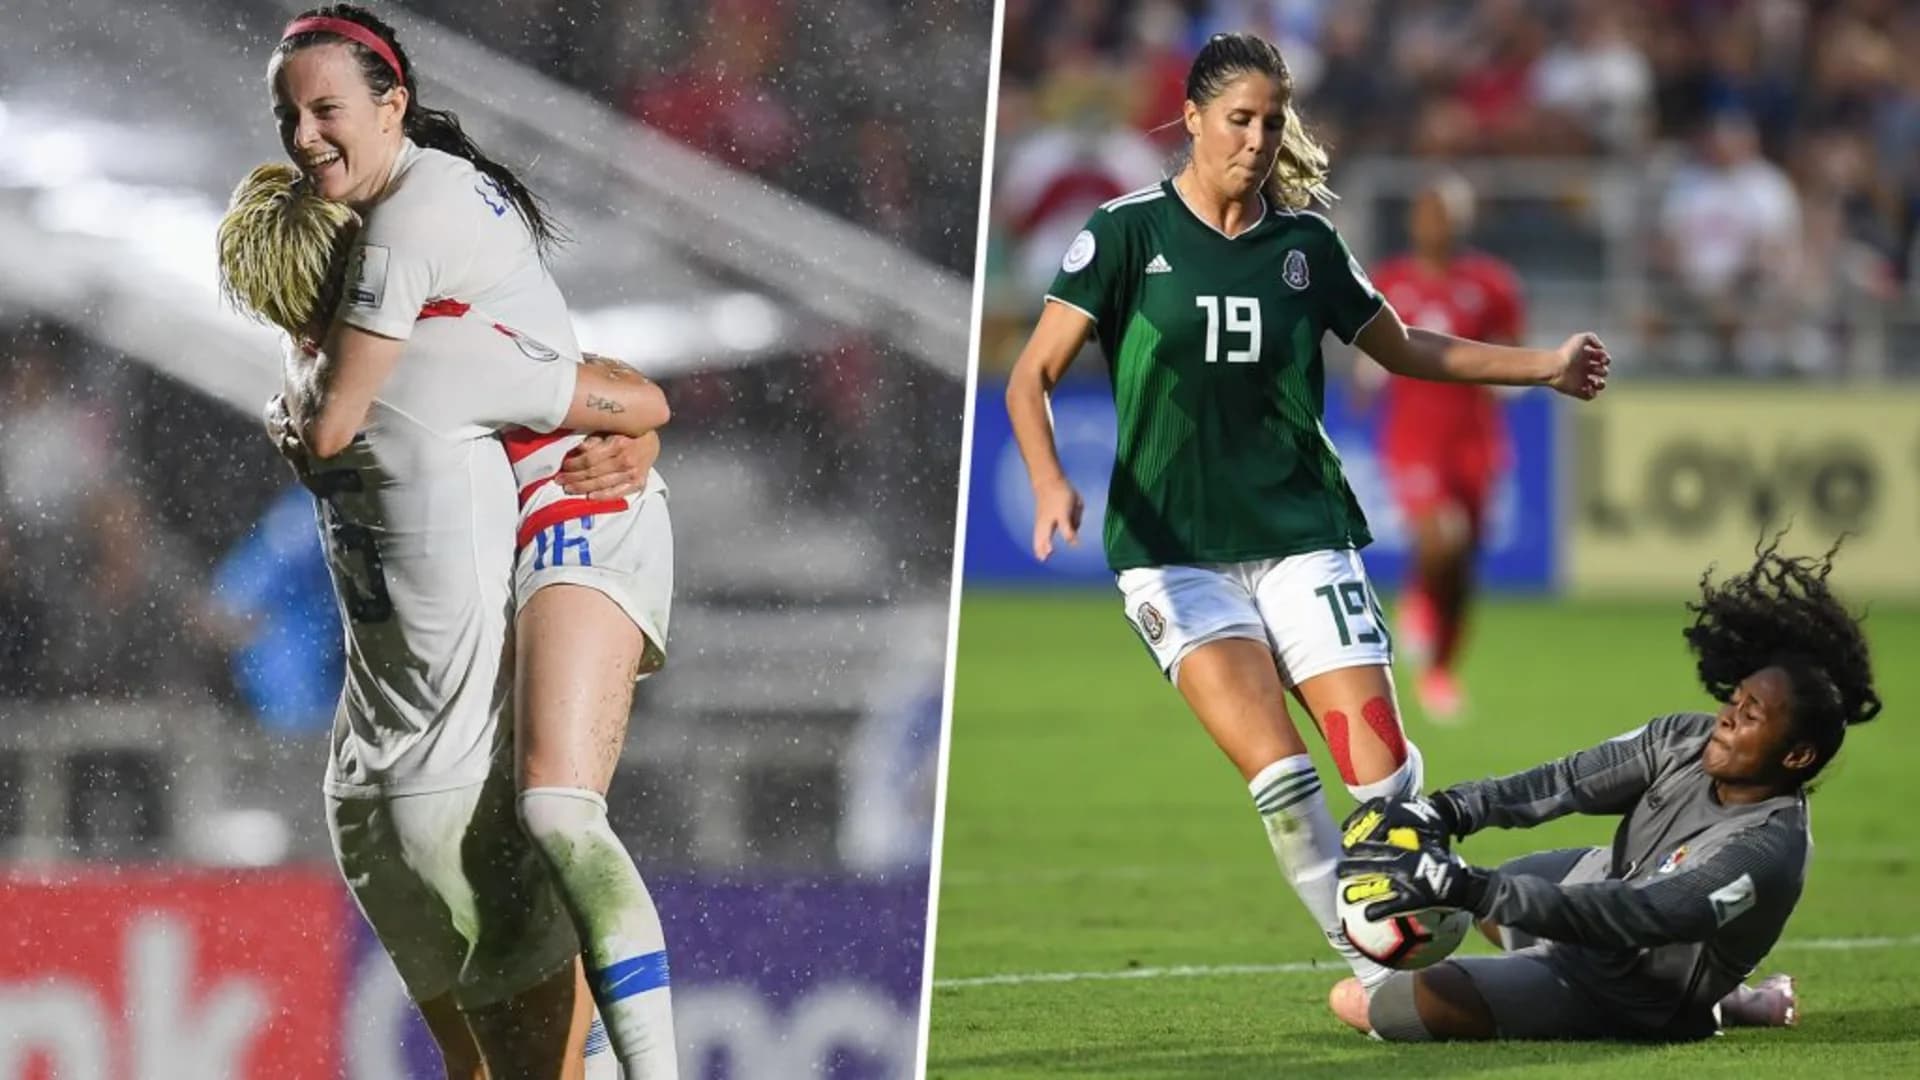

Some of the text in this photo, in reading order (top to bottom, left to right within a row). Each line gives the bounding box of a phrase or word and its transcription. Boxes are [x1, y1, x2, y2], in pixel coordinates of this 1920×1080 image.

[1196, 296, 1262, 362] 19
[533, 513, 592, 570] 16
[1315, 582, 1390, 646] 19
